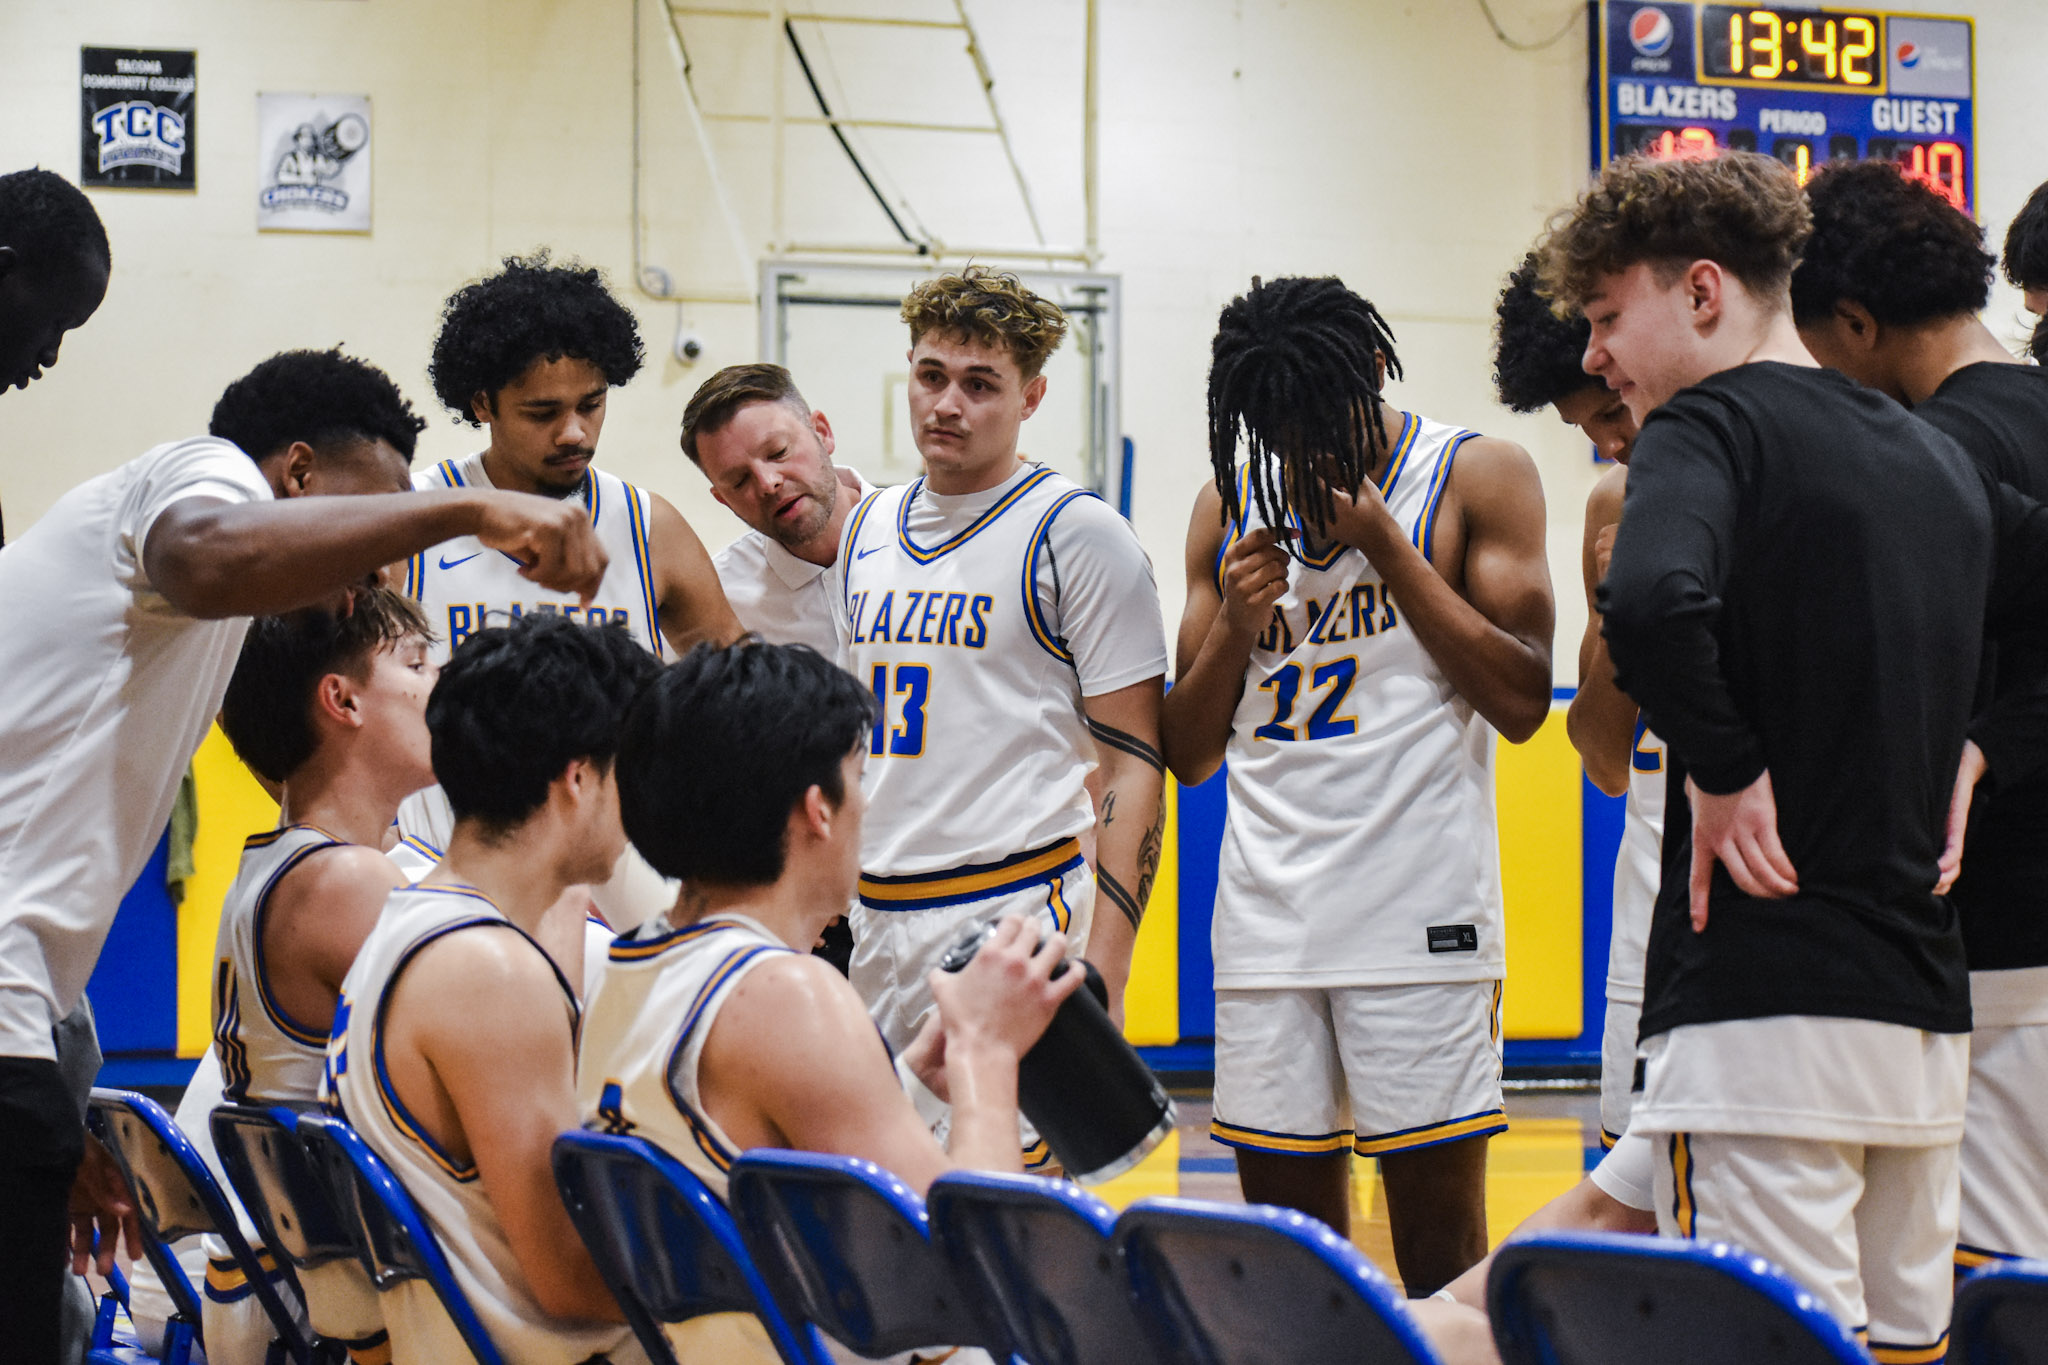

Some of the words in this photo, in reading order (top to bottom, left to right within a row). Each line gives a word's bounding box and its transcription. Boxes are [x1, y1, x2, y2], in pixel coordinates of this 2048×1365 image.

[115, 58, 163, 75] TACOMA
[1728, 10, 1876, 85] 13:42
[1617, 82, 1737, 121] BLAZERS
[1871, 98, 1960, 135] GUEST
[95, 102, 184, 150] TCC
[1758, 108, 1827, 136] PERIOD
[869, 661, 932, 760] 13
